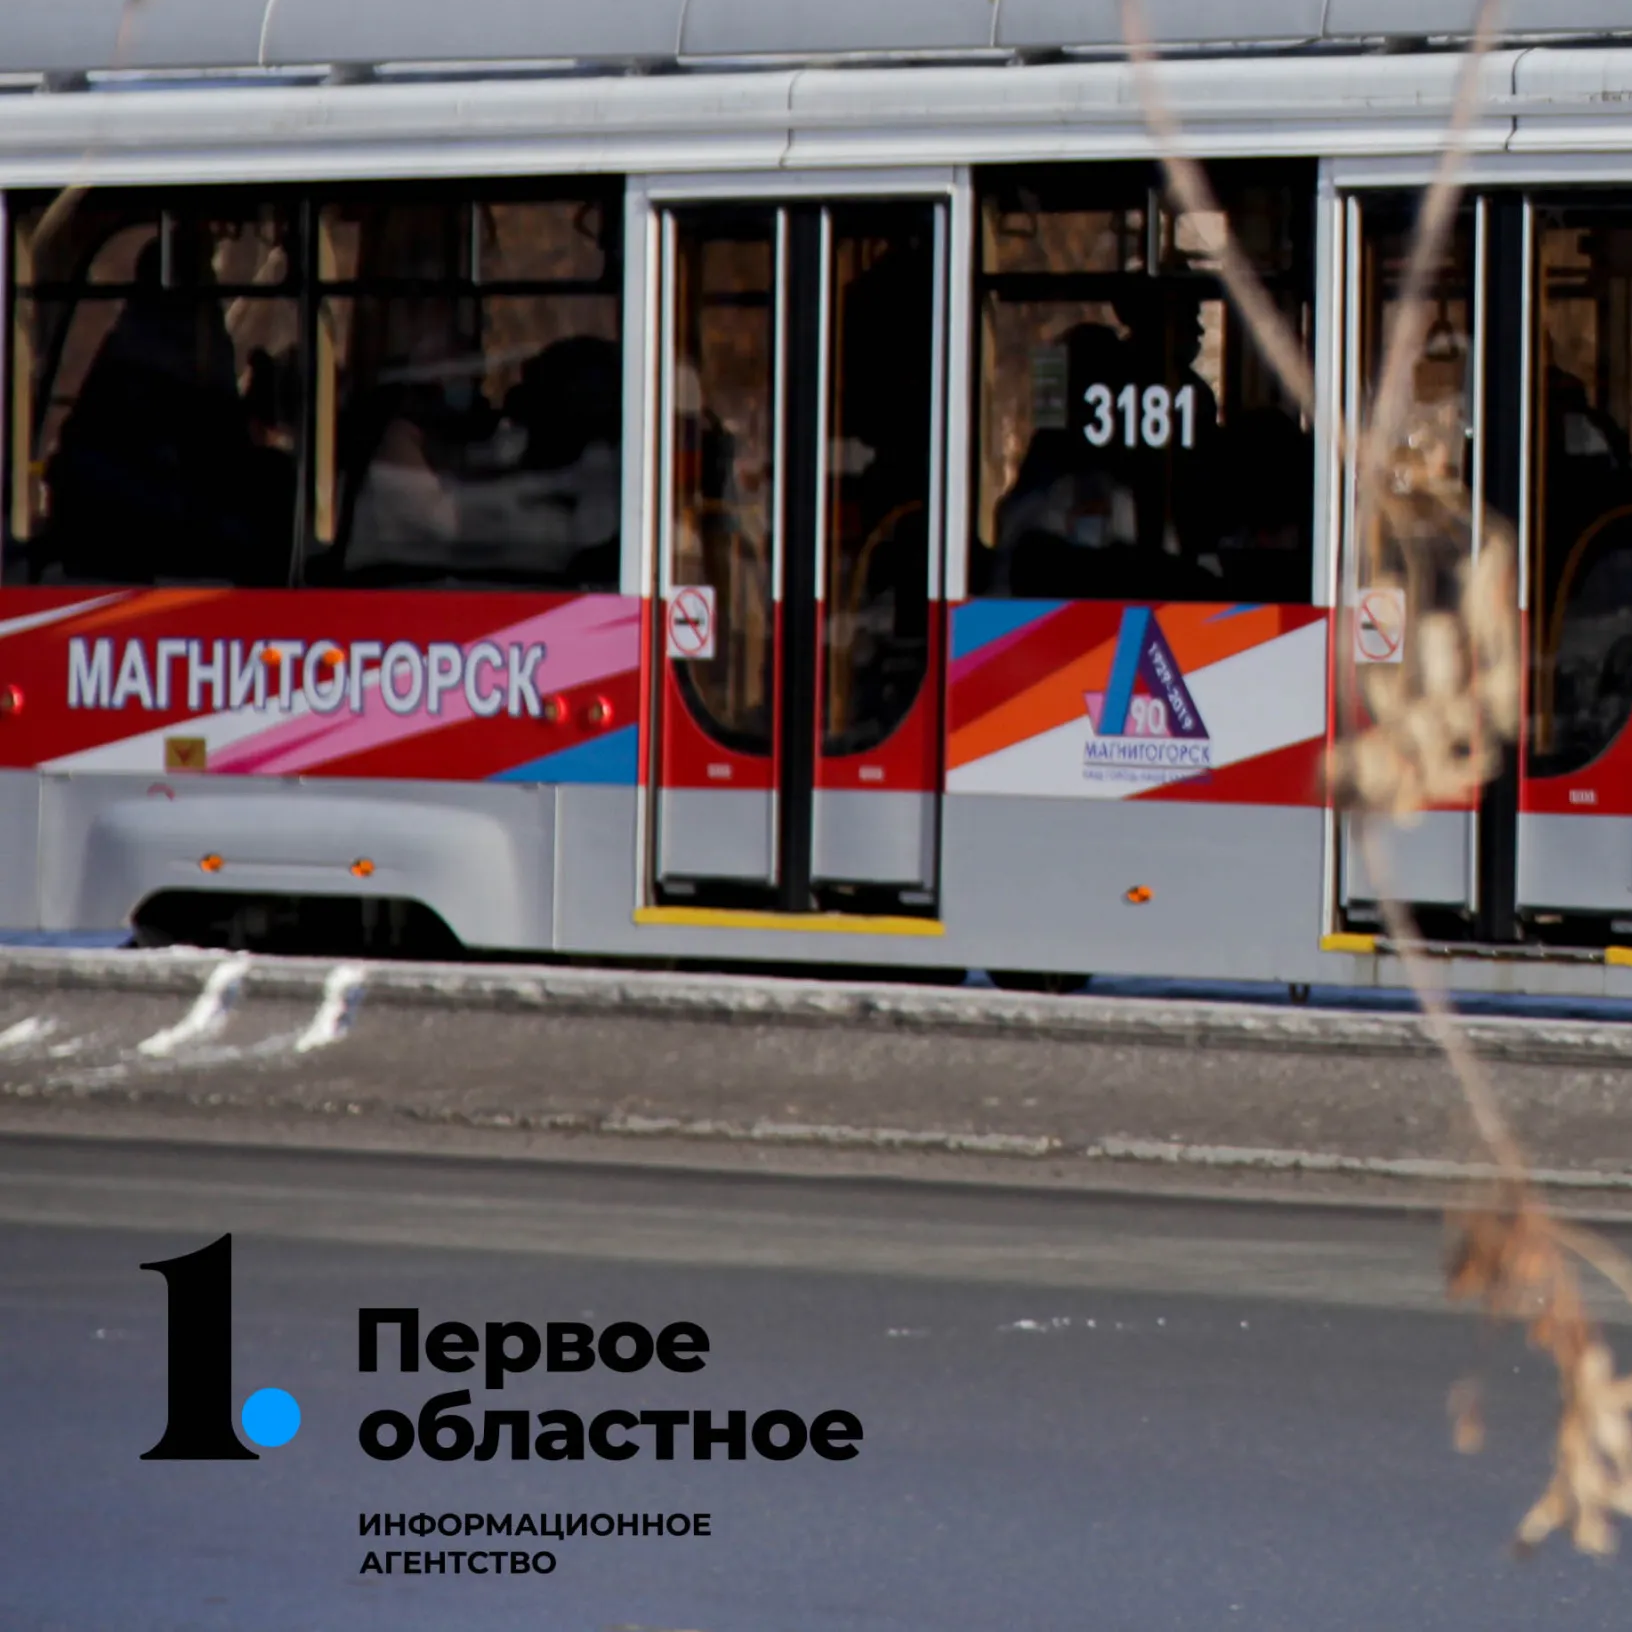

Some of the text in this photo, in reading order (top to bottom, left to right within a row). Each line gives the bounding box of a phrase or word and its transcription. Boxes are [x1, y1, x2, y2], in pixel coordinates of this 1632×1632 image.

[1083, 382, 1195, 449] 3181
[67, 636, 547, 718] МАГНИТОГОРСК
[1147, 640, 1195, 731] 1929-2019
[1130, 697, 1168, 735] 90
[1085, 739, 1211, 764] МАГНИТОГОРСК
